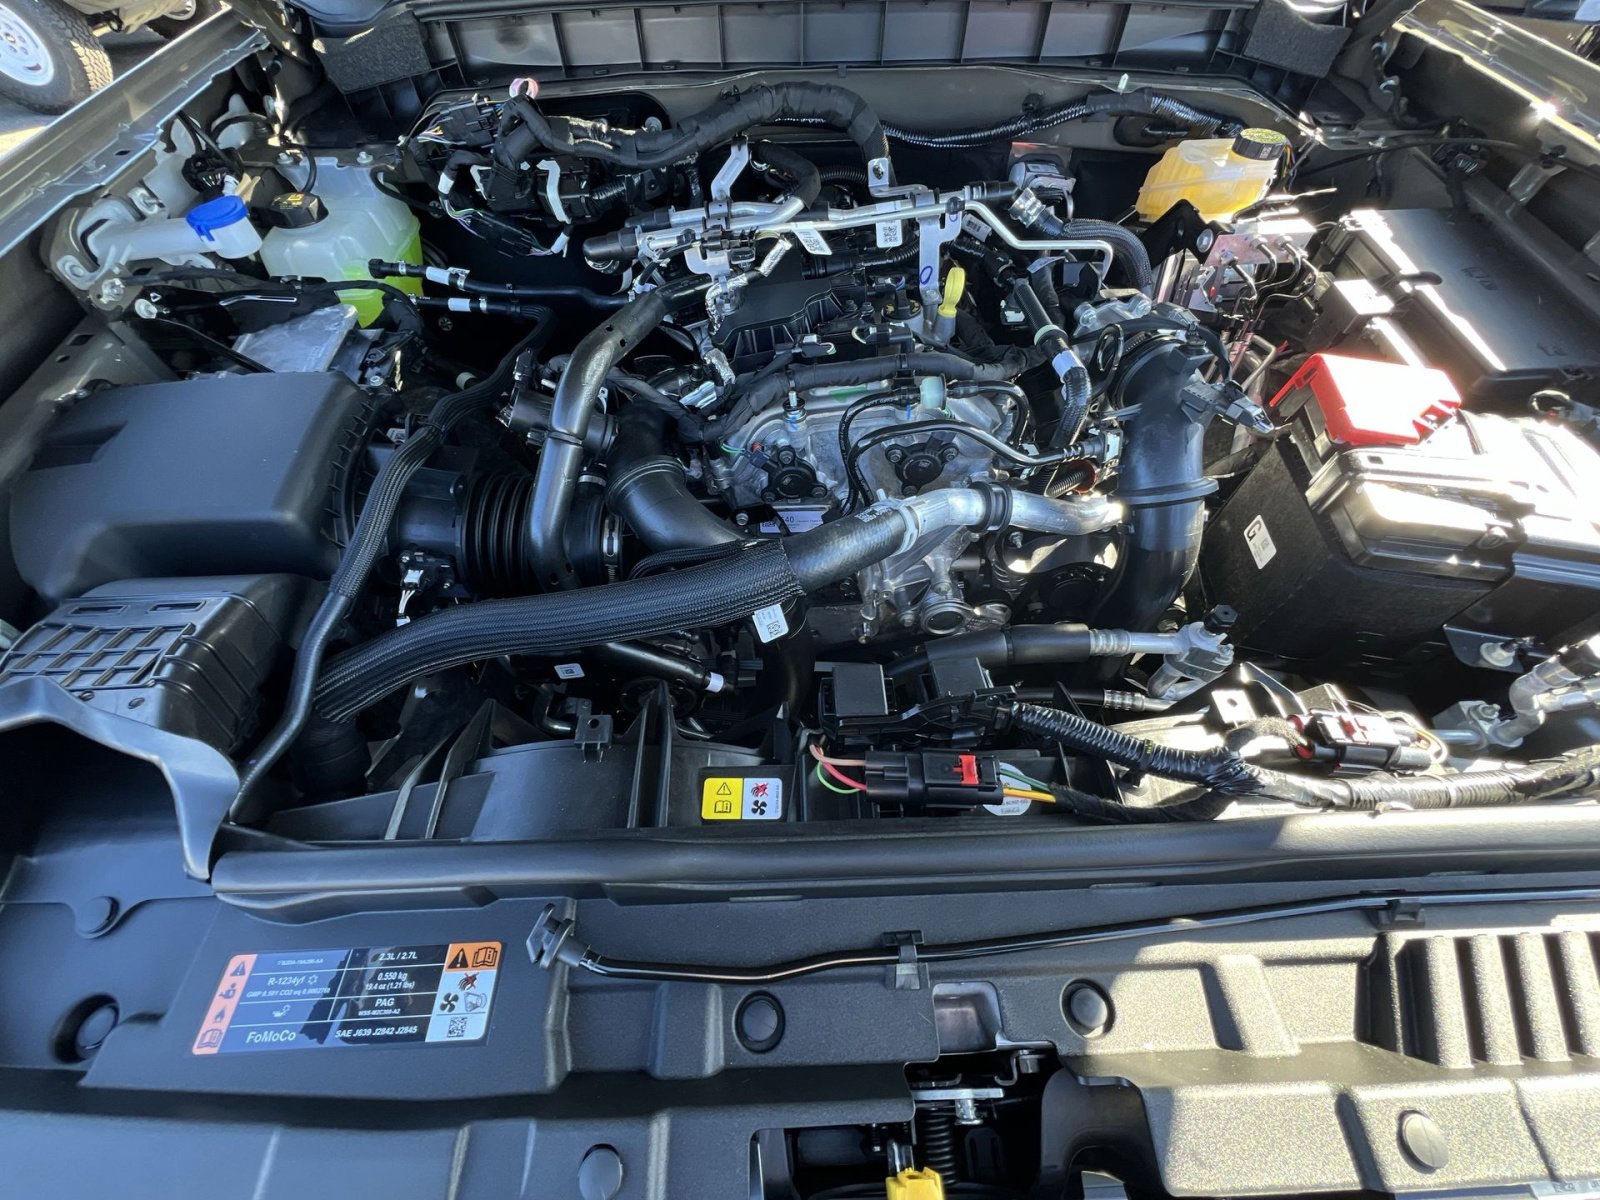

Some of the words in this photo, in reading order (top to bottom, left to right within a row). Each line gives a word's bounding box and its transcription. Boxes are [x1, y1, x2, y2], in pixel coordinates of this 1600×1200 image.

[379, 952, 395, 961] 2.3L
[396, 952, 401, 960] /
[401, 951, 418, 960] 2.7L
[267, 976, 306, 986] R-1234yf
[377, 972, 397, 981] 0.550
[398, 972, 408, 982] kg
[375, 998, 395, 1007] PAG
[246, 1030, 296, 1043] FoMoCo
[335, 1029, 353, 1038] SAE
[352, 1029, 372, 1037] J639
[372, 1027, 395, 1036] J2842
[395, 1026, 418, 1035] J2845
